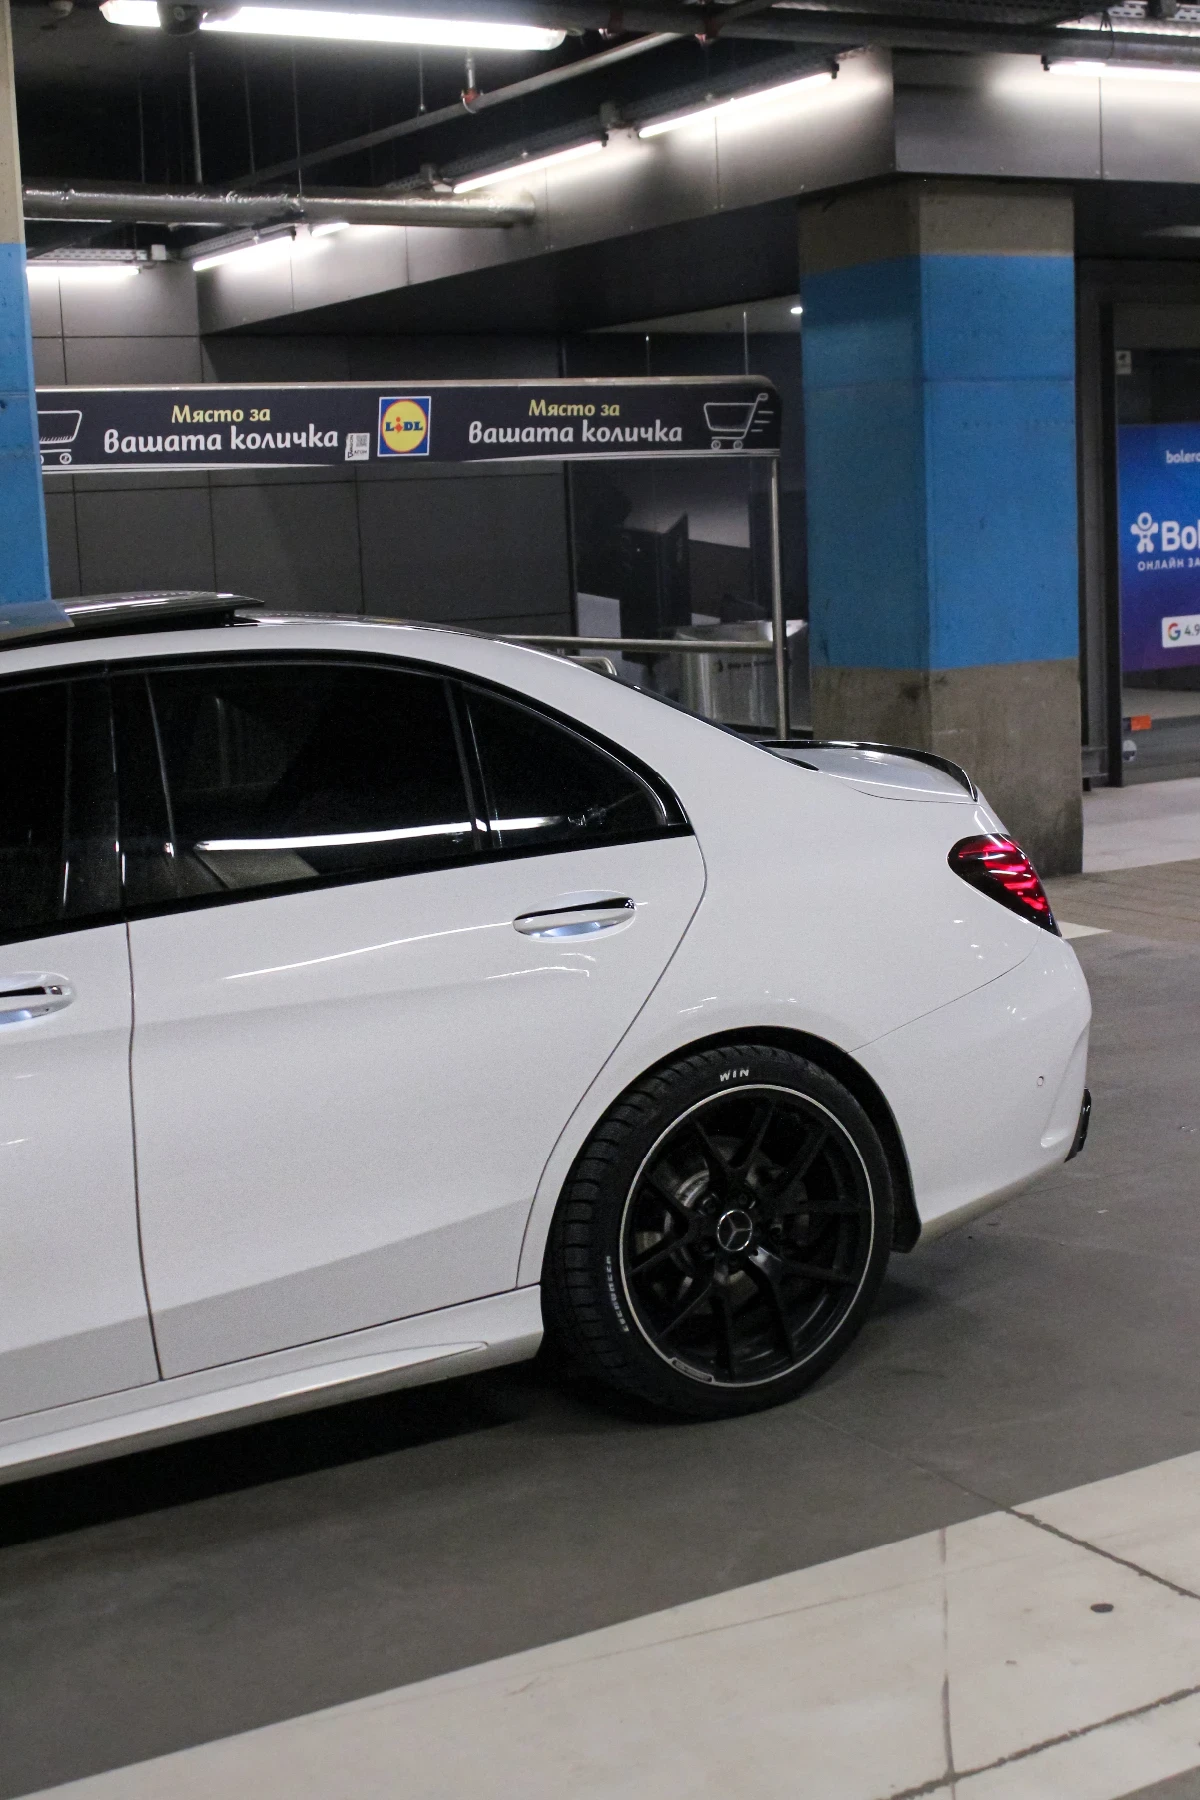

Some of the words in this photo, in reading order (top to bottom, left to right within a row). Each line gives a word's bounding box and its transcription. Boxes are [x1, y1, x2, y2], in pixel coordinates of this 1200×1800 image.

[172, 405, 244, 423] Място
[249, 408, 271, 422] за
[528, 399, 596, 416] Място
[600, 404, 620, 416] за
[104, 428, 222, 453] вашата
[230, 423, 339, 450] количка
[468, 420, 574, 444] вашата
[582, 419, 683, 442] количка
[1137, 557, 1185, 571] ОНЛАЙН
[719, 1067, 750, 1082] WIN
